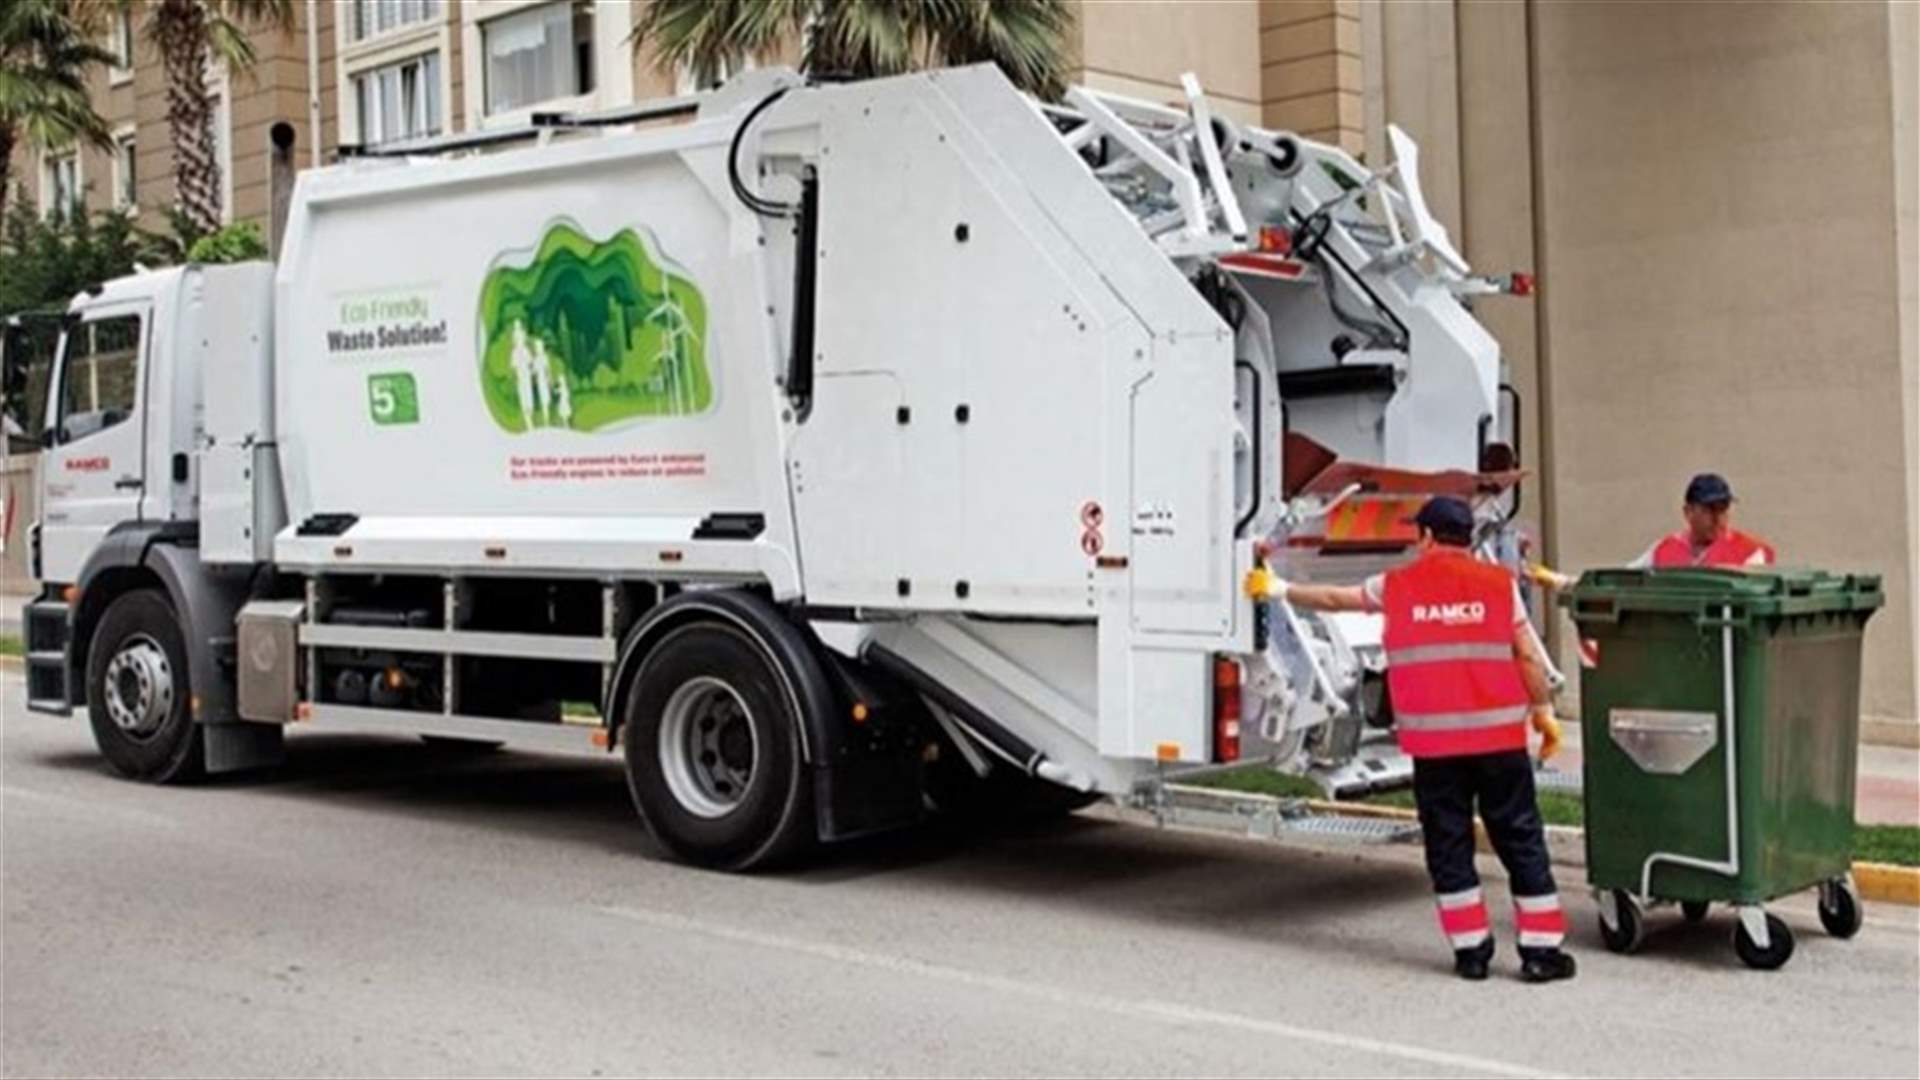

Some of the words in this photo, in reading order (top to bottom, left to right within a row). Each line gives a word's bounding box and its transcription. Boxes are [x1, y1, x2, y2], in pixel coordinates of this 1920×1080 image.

[327, 330, 375, 353] Waste
[377, 320, 447, 348] Solution!
[372, 379, 395, 415] 5
[65, 457, 110, 470] RAMCO
[1412, 602, 1485, 622] RAMCO
